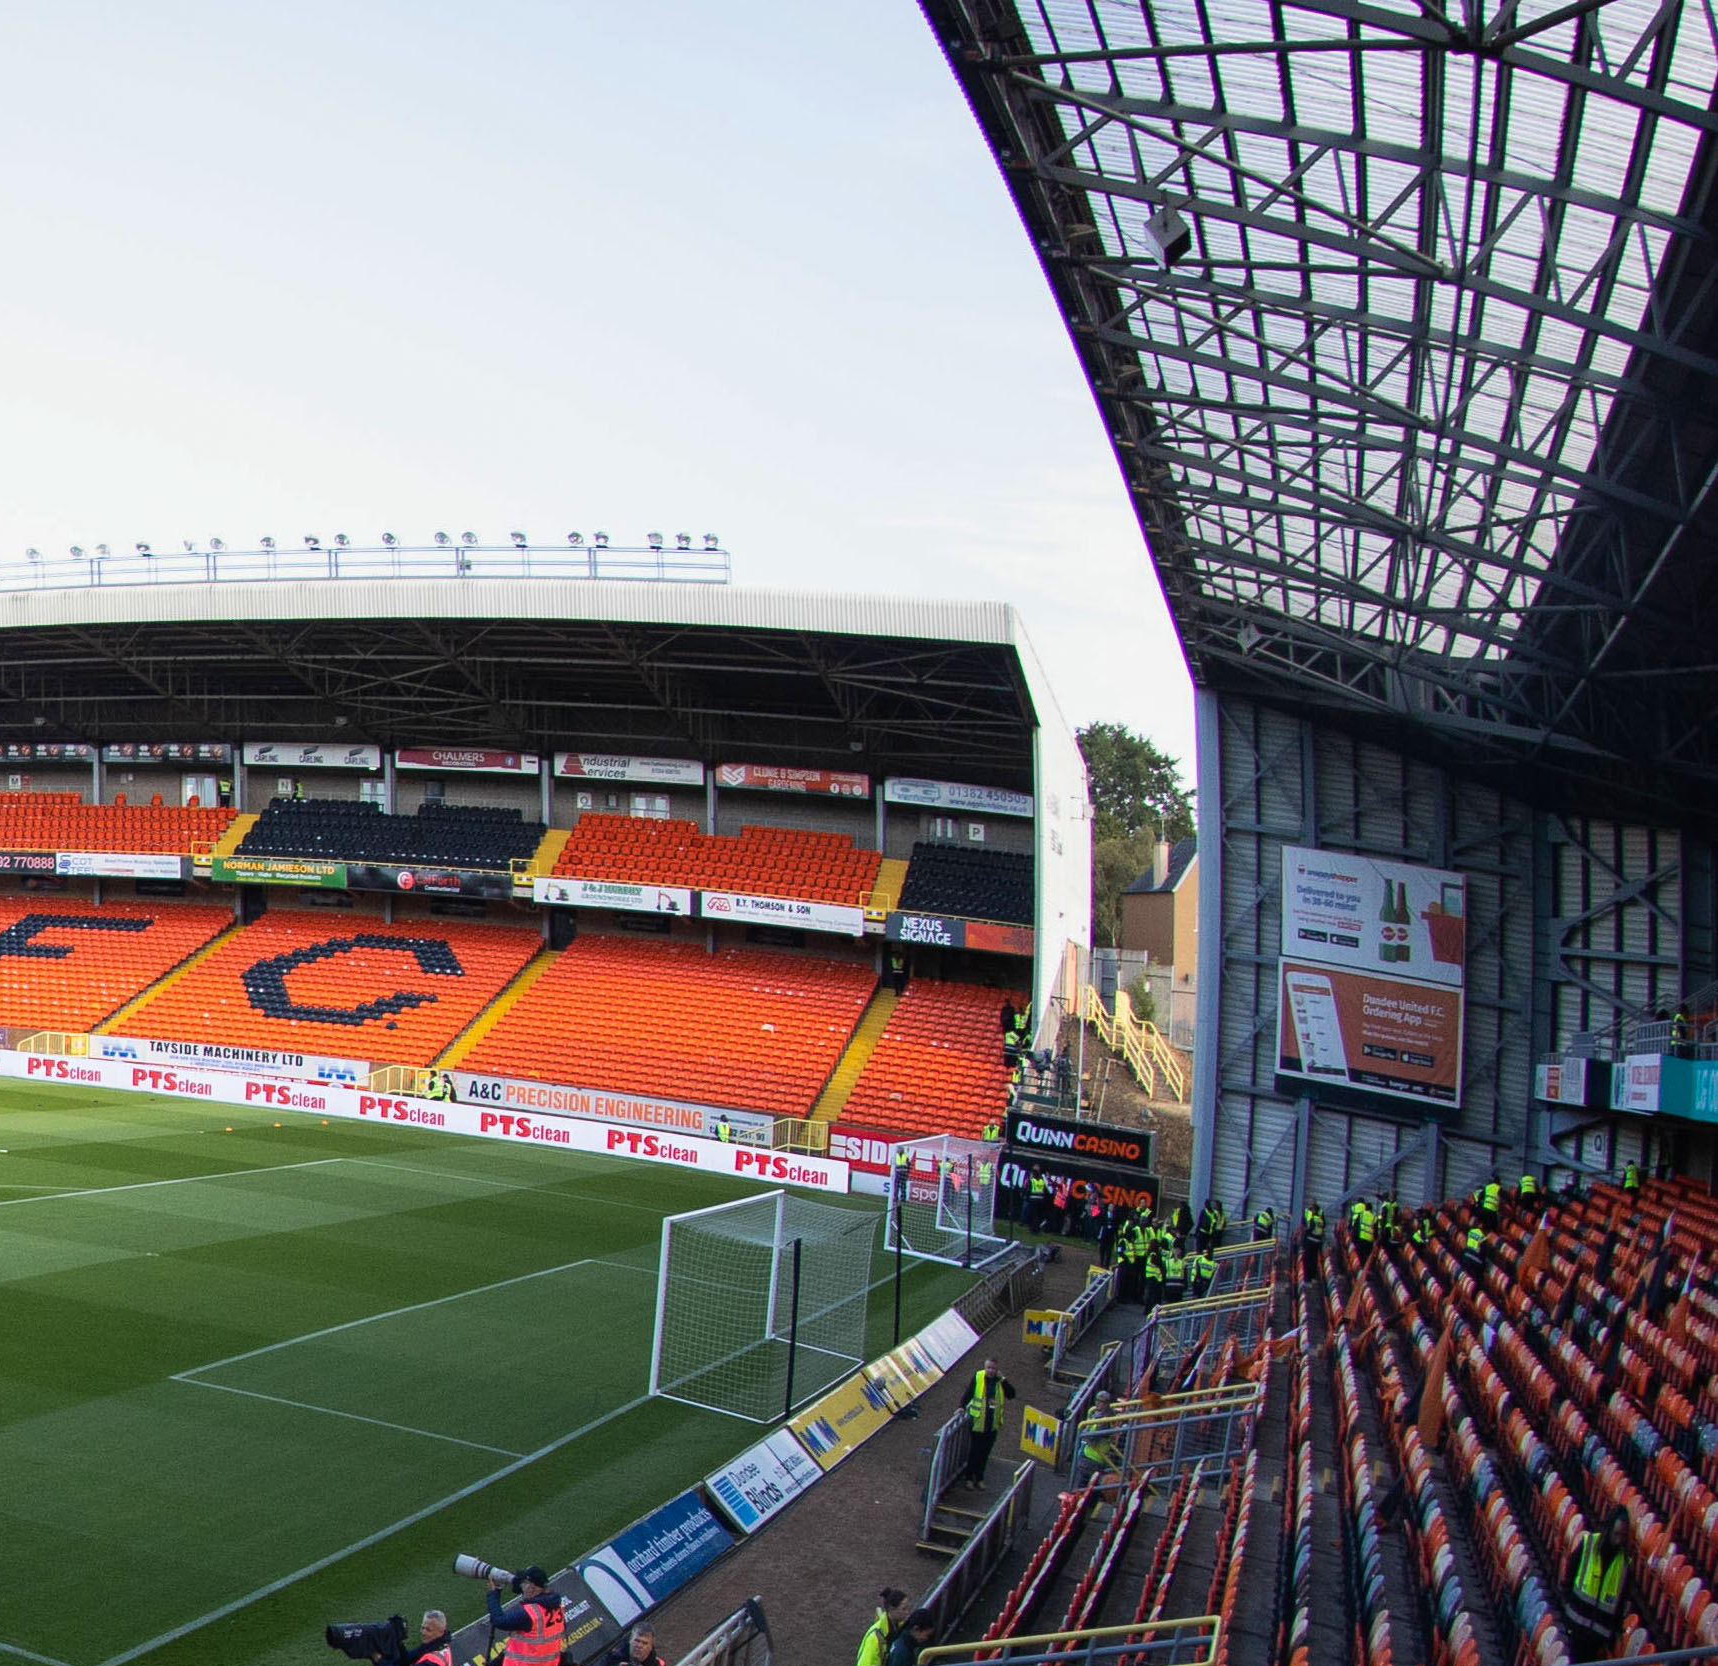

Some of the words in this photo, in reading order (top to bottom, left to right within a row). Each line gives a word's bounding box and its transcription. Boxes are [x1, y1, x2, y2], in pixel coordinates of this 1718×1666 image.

[433, 751, 485, 762] CHALMERS
[948, 786, 983, 799] 01382
[972, 827, 981, 838] P
[14, 855, 55, 870] 770888
[223, 861, 264, 871] NORMAN
[266, 863, 315, 873] JAMIESON
[317, 865, 335, 875] LTD
[751, 899, 785, 912] THOMSON
[796, 905, 811, 915] SON
[903, 917, 943, 931] NEXUS
[900, 928, 952, 946] SIGNAGE
[1363, 993, 1398, 1008] Dundee
[1399, 999, 1429, 1014] United
[1363, 1005, 1403, 1023] Ordering
[1404, 1013, 1423, 1027] App
[150, 1041, 200, 1057] TAYSIDE
[203, 1046, 278, 1064] MACHINERY
[282, 1053, 304, 1068] LTD
[469, 1080, 502, 1101] A&C
[506, 1083, 591, 1114] PRECISION
[594, 1096, 704, 1130] ENGINEERING
[1025, 1420, 1057, 1448] MKM
[744, 1478, 784, 1515] Blinds
[626, 1540, 661, 1574] orchard
[653, 1528, 685, 1553] timber
[679, 1507, 714, 1541] products
